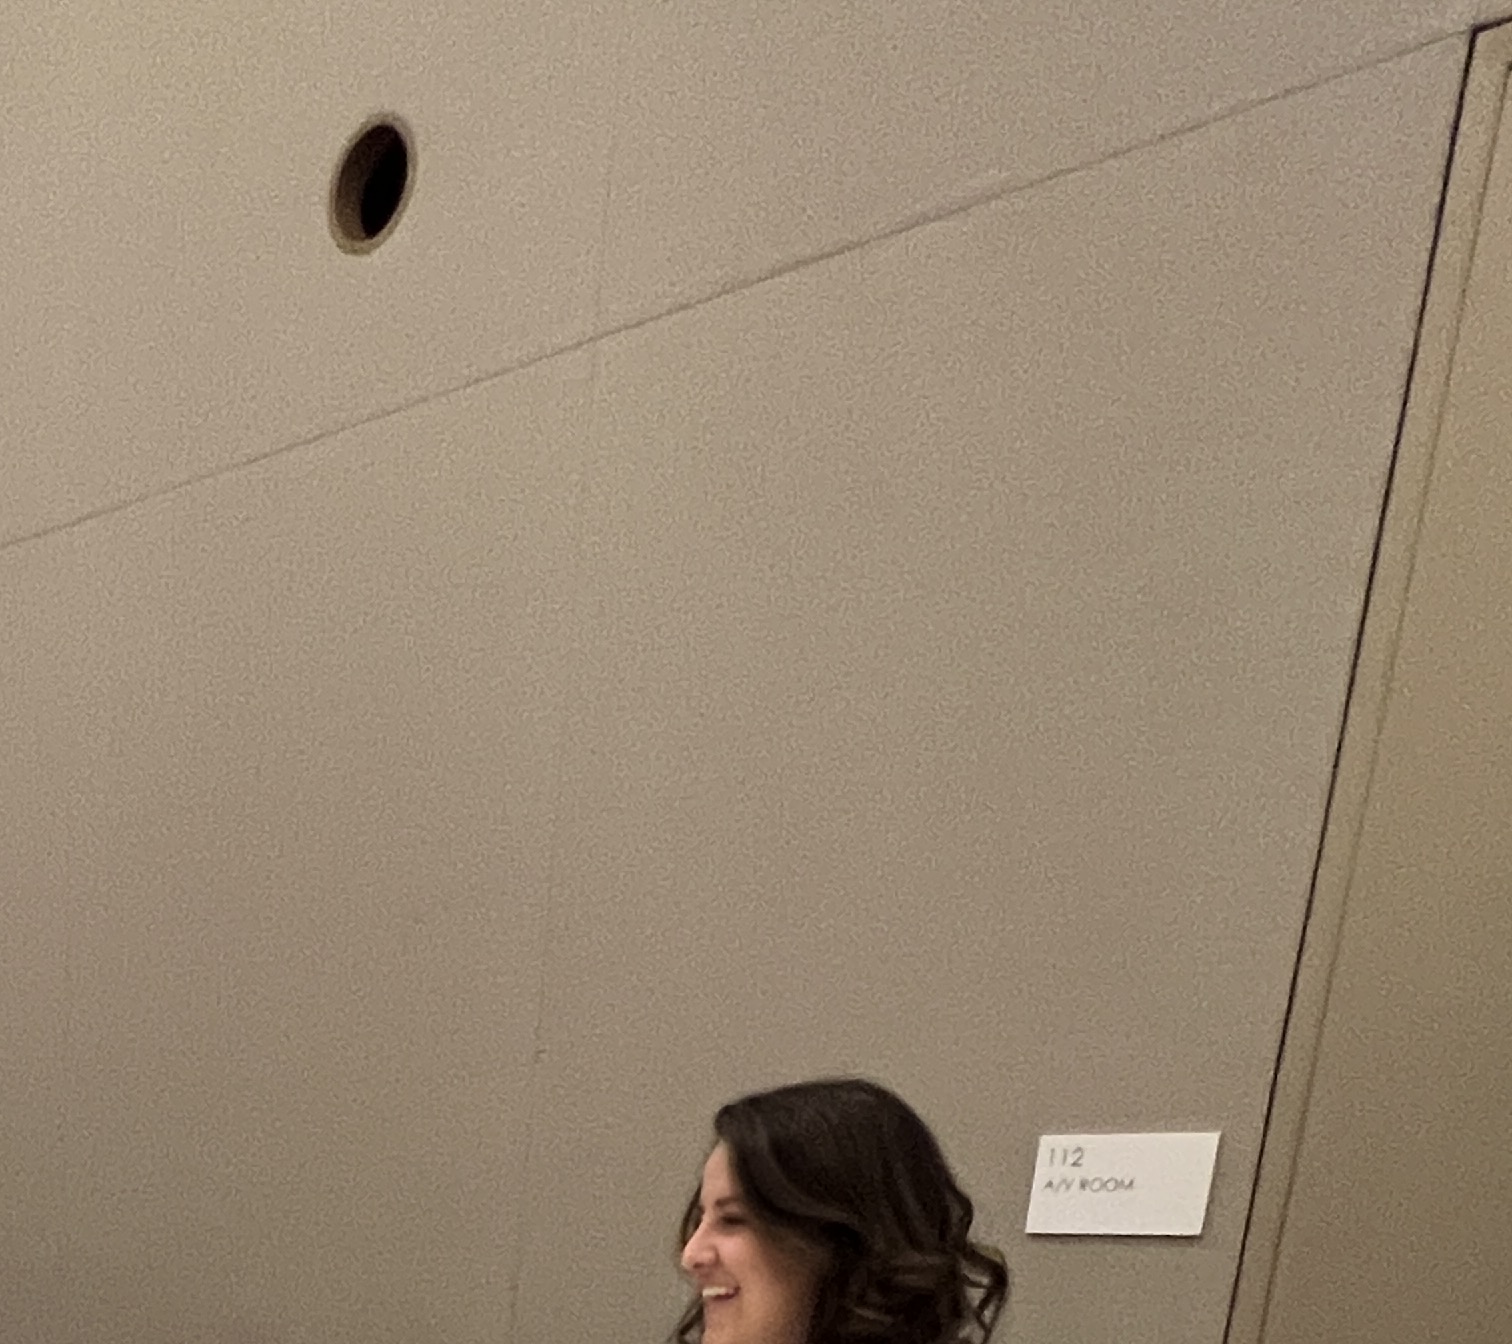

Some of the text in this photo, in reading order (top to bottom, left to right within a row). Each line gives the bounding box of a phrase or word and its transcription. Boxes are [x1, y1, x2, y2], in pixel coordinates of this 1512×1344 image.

[1048, 1146, 1084, 1168] 112
[1043, 1177, 1135, 1193] A/V ROOM
